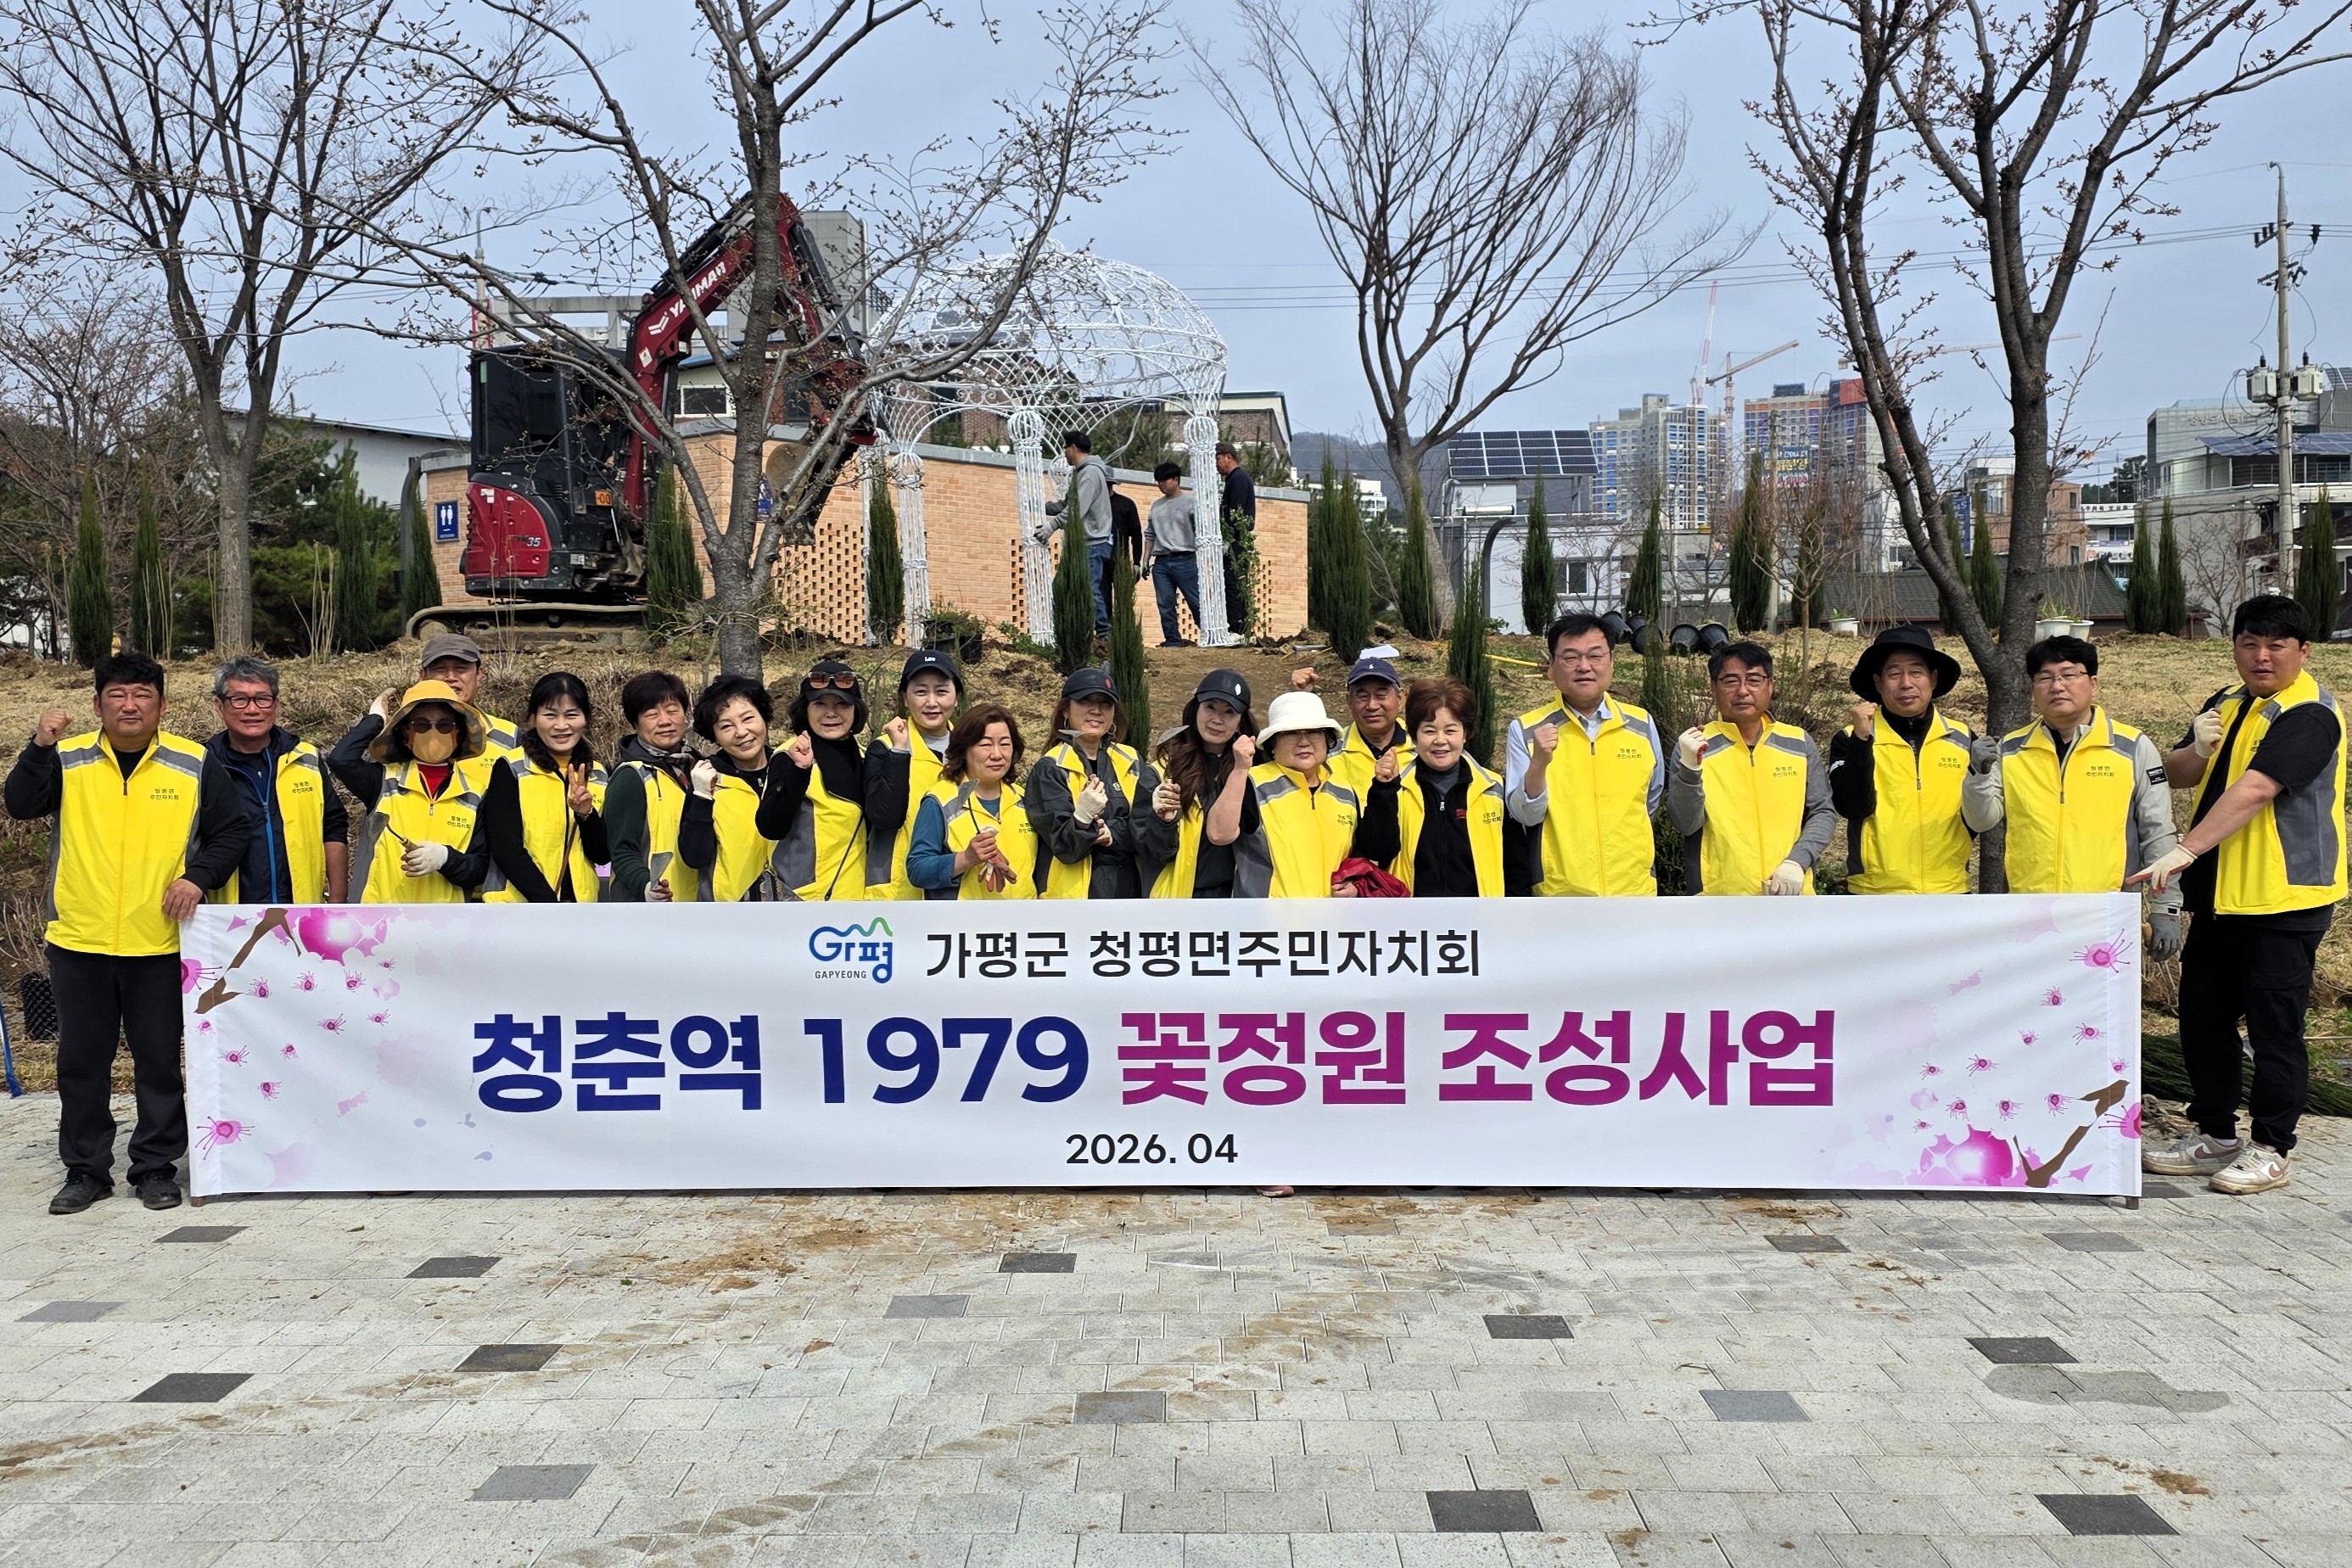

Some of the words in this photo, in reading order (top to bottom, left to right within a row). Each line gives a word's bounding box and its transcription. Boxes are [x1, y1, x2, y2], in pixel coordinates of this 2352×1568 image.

[927, 932, 1068, 978] 가평군
[1089, 929, 1480, 978] 청평면주민자치회
[815, 970, 867, 979] GAPYEONG
[472, 1011, 762, 1112] 청춘역
[803, 1016, 1089, 1105] 1979
[1117, 1011, 1407, 1106] 꽃정원
[1438, 1010, 1835, 1106] 조성사업
[1066, 1134, 1176, 1164] 2026.
[1187, 1133, 1238, 1164] 04
